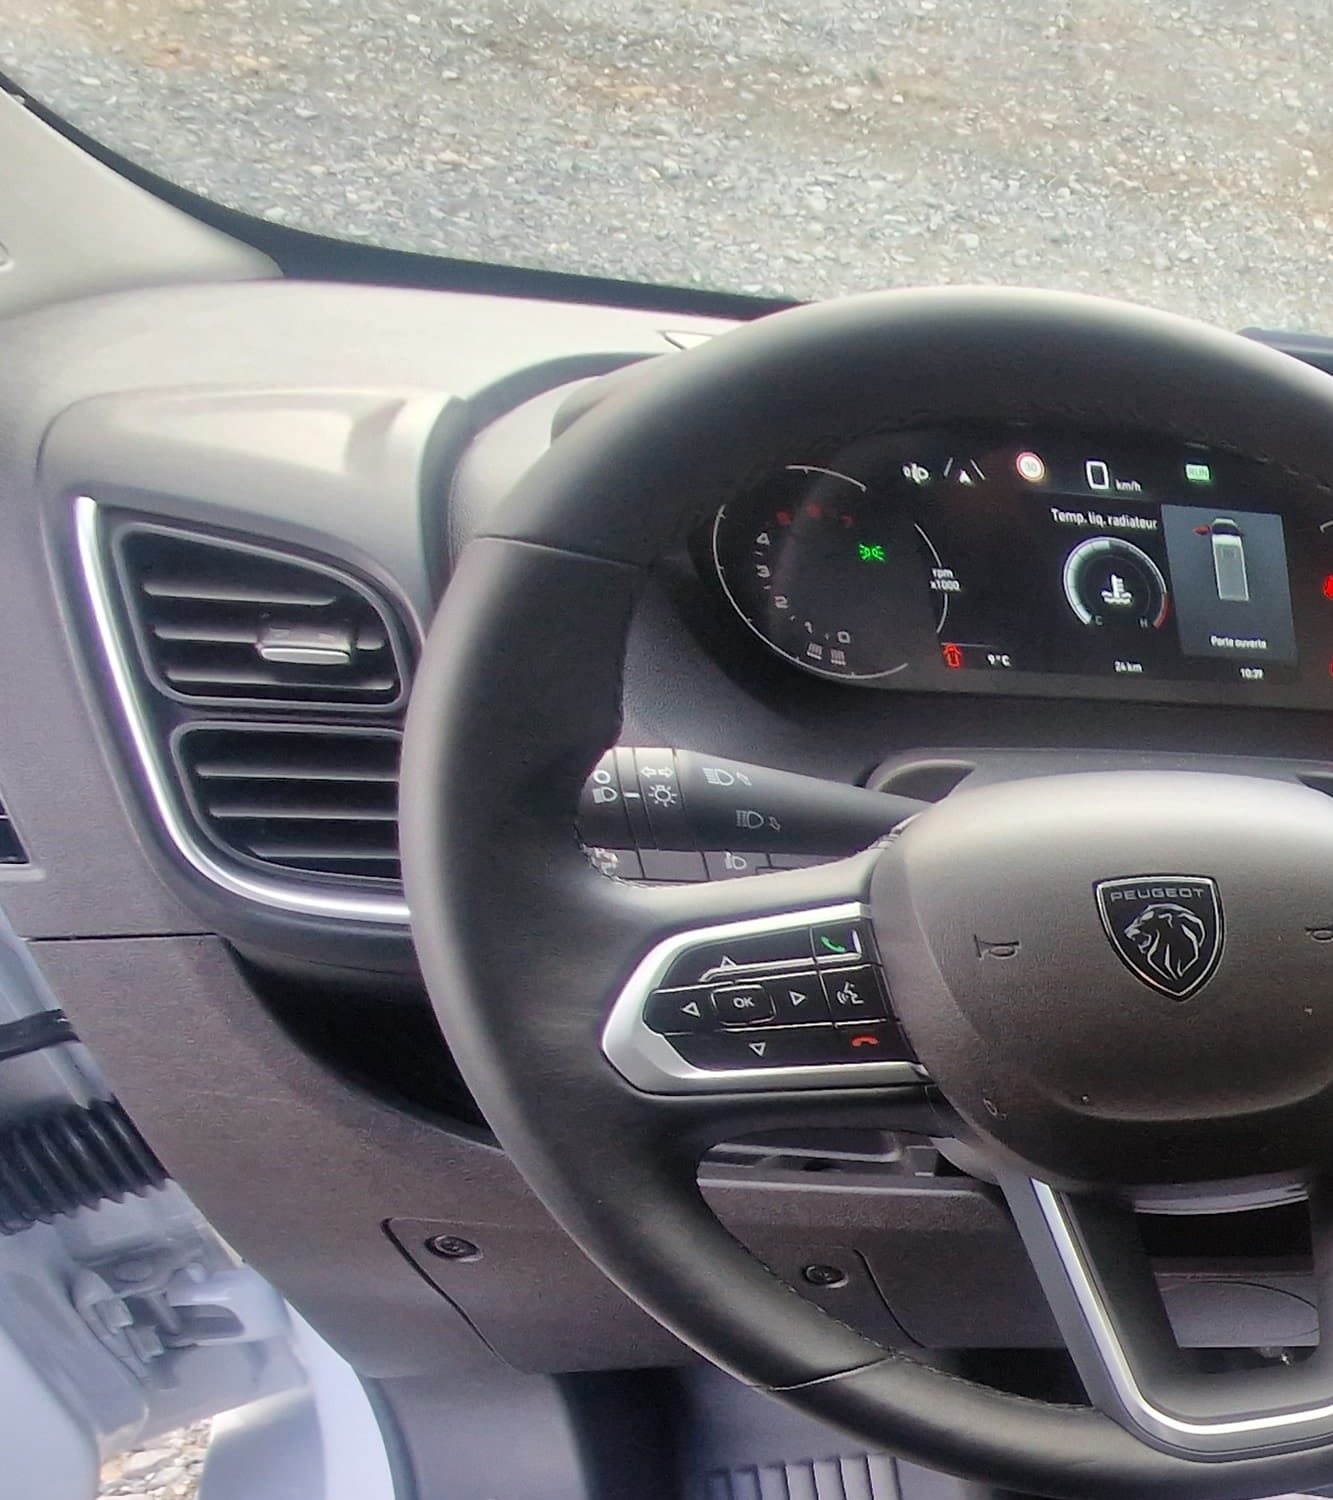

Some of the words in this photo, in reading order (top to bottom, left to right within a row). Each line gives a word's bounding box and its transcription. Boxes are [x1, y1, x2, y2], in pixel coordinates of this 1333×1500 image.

[1085, 460, 1109, 490] 0
[1115, 479, 1142, 492] km/h
[1051, 507, 1088, 525] Temp.
[1088, 512, 1106, 527] liq.
[1108, 513, 1157, 529] radiateur
[756, 532, 770, 546] 4
[756, 565, 771, 578] 3
[931, 568, 953, 579] rpm
[774, 596, 789, 609] 2
[1126, 661, 1142, 673] km
[1110, 887, 1205, 903] PEUGEOT
[733, 996, 755, 1009] OK
